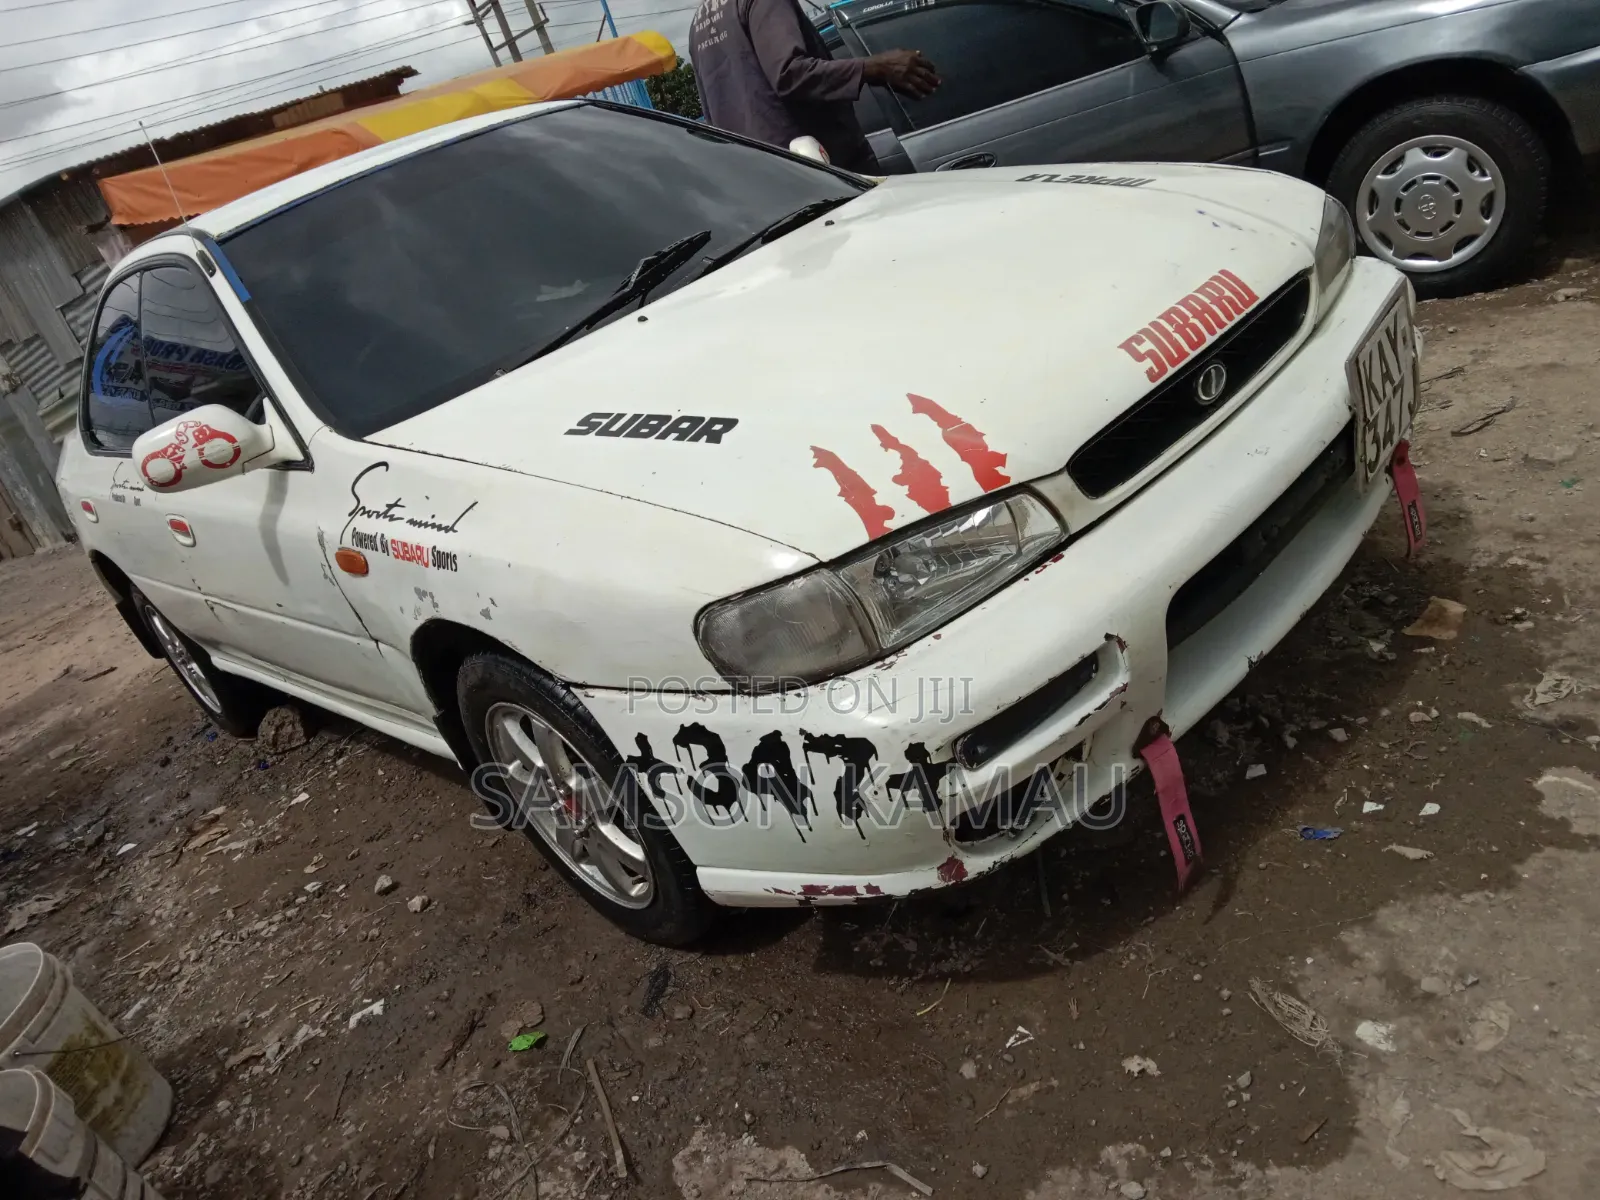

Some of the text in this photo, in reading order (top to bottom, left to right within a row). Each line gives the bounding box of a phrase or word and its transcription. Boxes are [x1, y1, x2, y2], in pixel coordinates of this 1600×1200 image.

[862, 1, 893, 13] COROLLA
[1117, 269, 1260, 383] SUBARU
[1362, 310, 1402, 418] KAY
[563, 412, 739, 444] SUBAR
[351, 527, 458, 572] Powered By SUBARU Sports
